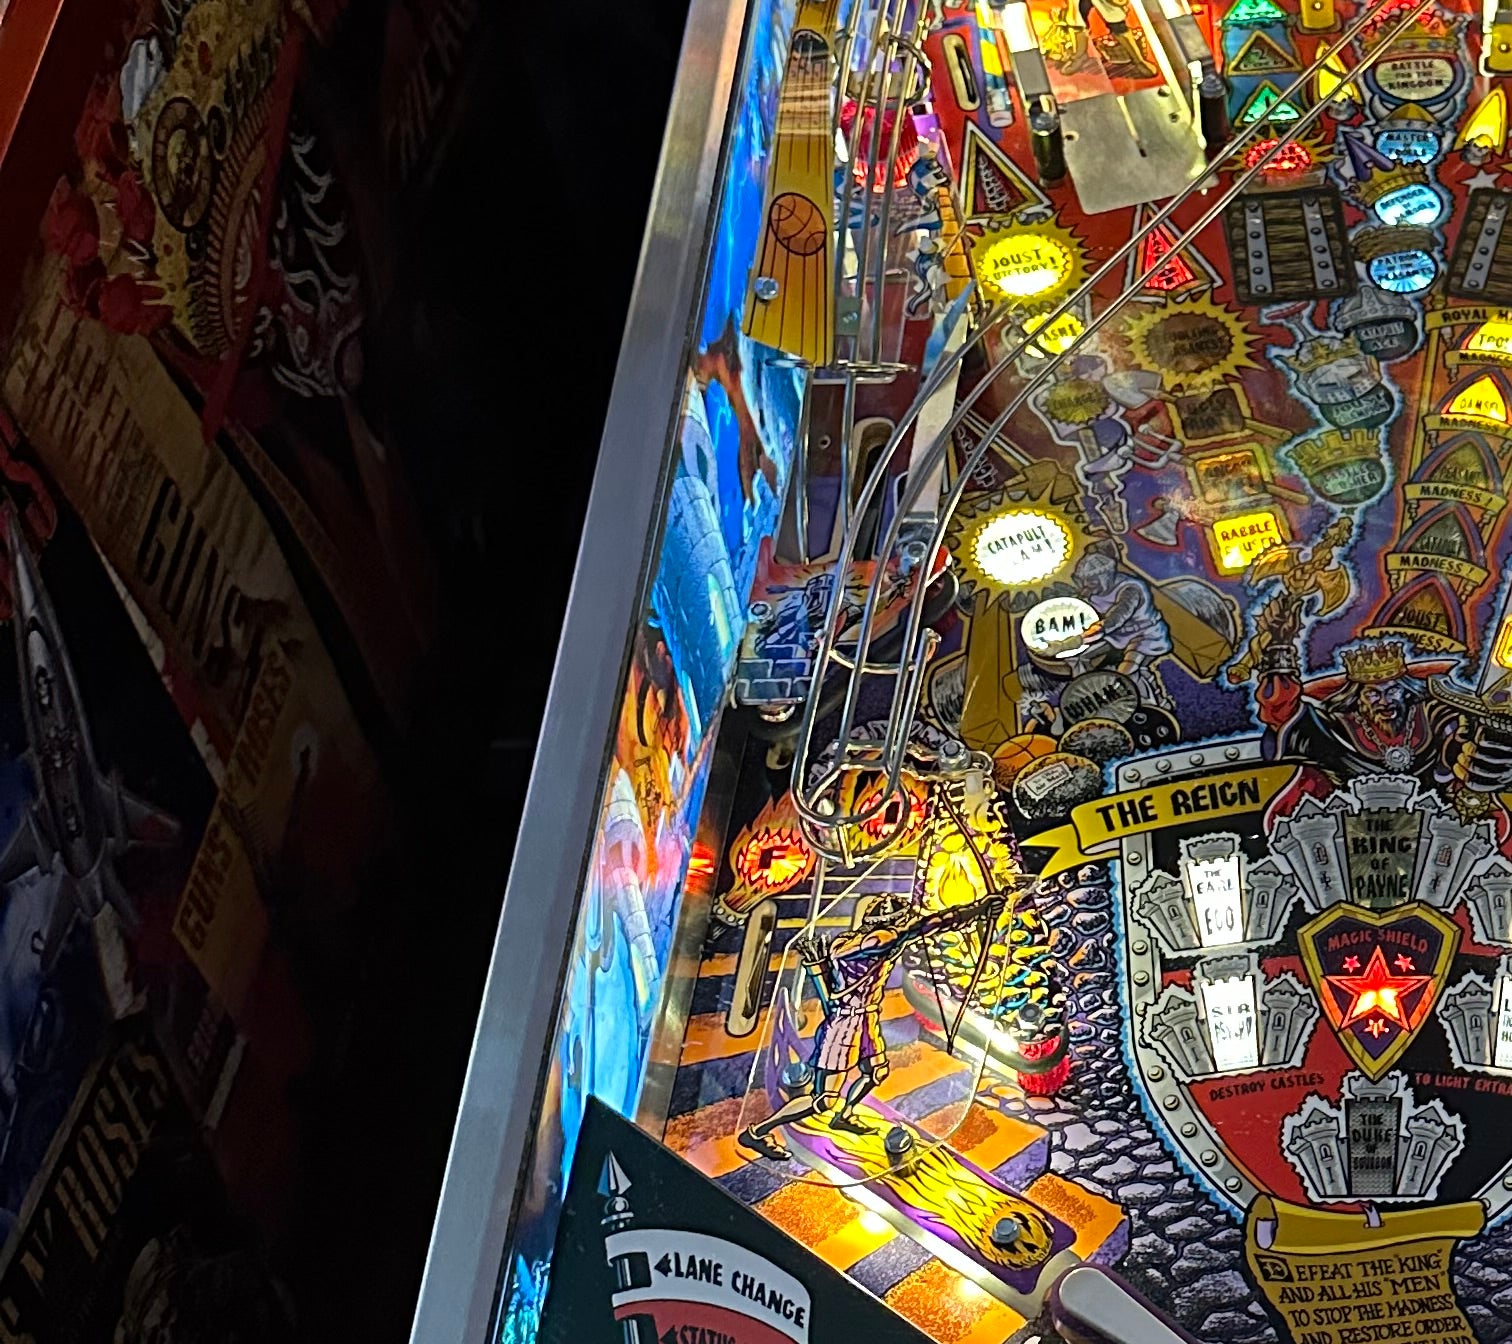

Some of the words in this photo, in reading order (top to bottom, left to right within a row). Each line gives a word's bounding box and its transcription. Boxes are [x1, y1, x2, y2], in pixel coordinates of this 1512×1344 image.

[993, 248, 1042, 270] JOUST
[1441, 309, 1488, 323] ROYAL
[1420, 486, 1482, 503] MADNESS
[987, 525, 1048, 554] CATAPULT
[1221, 521, 1272, 541] RABBLE
[1400, 556, 1463, 573] MADNESS
[1036, 612, 1086, 635] BAM!
[1399, 608, 1441, 628] JOUST
[1065, 676, 1133, 720] WHAM!
[1095, 794, 1158, 833] THE
[1171, 775, 1262, 818] REIGN
[1365, 818, 1394, 832] THE
[1352, 836, 1412, 854] KING
[758, 845, 791, 870] F
[1370, 857, 1391, 871] OF
[1204, 869, 1221, 878] THE
[1355, 874, 1409, 898] PAYNE
[1327, 930, 1373, 952] MAGIC
[1376, 929, 1429, 954] SHIELD
[1211, 1003, 1250, 1017] SIR
[1209, 1080, 1266, 1102] DESTROY
[1270, 1072, 1325, 1092] CASTLES
[1415, 1072, 1431, 1086] TO
[1434, 1075, 1471, 1092] LIGHT
[1360, 1113, 1384, 1126] THE
[1352, 1128, 1393, 1144] DUKE
[1256, 1256, 1354, 1283] DEFEAT
[1357, 1258, 1395, 1280] THE
[674, 1252, 724, 1288] LANE
[731, 1269, 806, 1329] CHANGE
[1279, 1286, 1315, 1304] AND
[1318, 1284, 1352, 1301] ALL
[1352, 1281, 1383, 1299] HIS
[1289, 1309, 1310, 1328] TO
[1314, 1306, 1352, 1325] STOP
[1357, 1303, 1385, 1323] THE
[1388, 1294, 1455, 1318] MADNESS
[1338, 1321, 1413, 1344] RESTORE
[1415, 1315, 1466, 1335] ORDER
